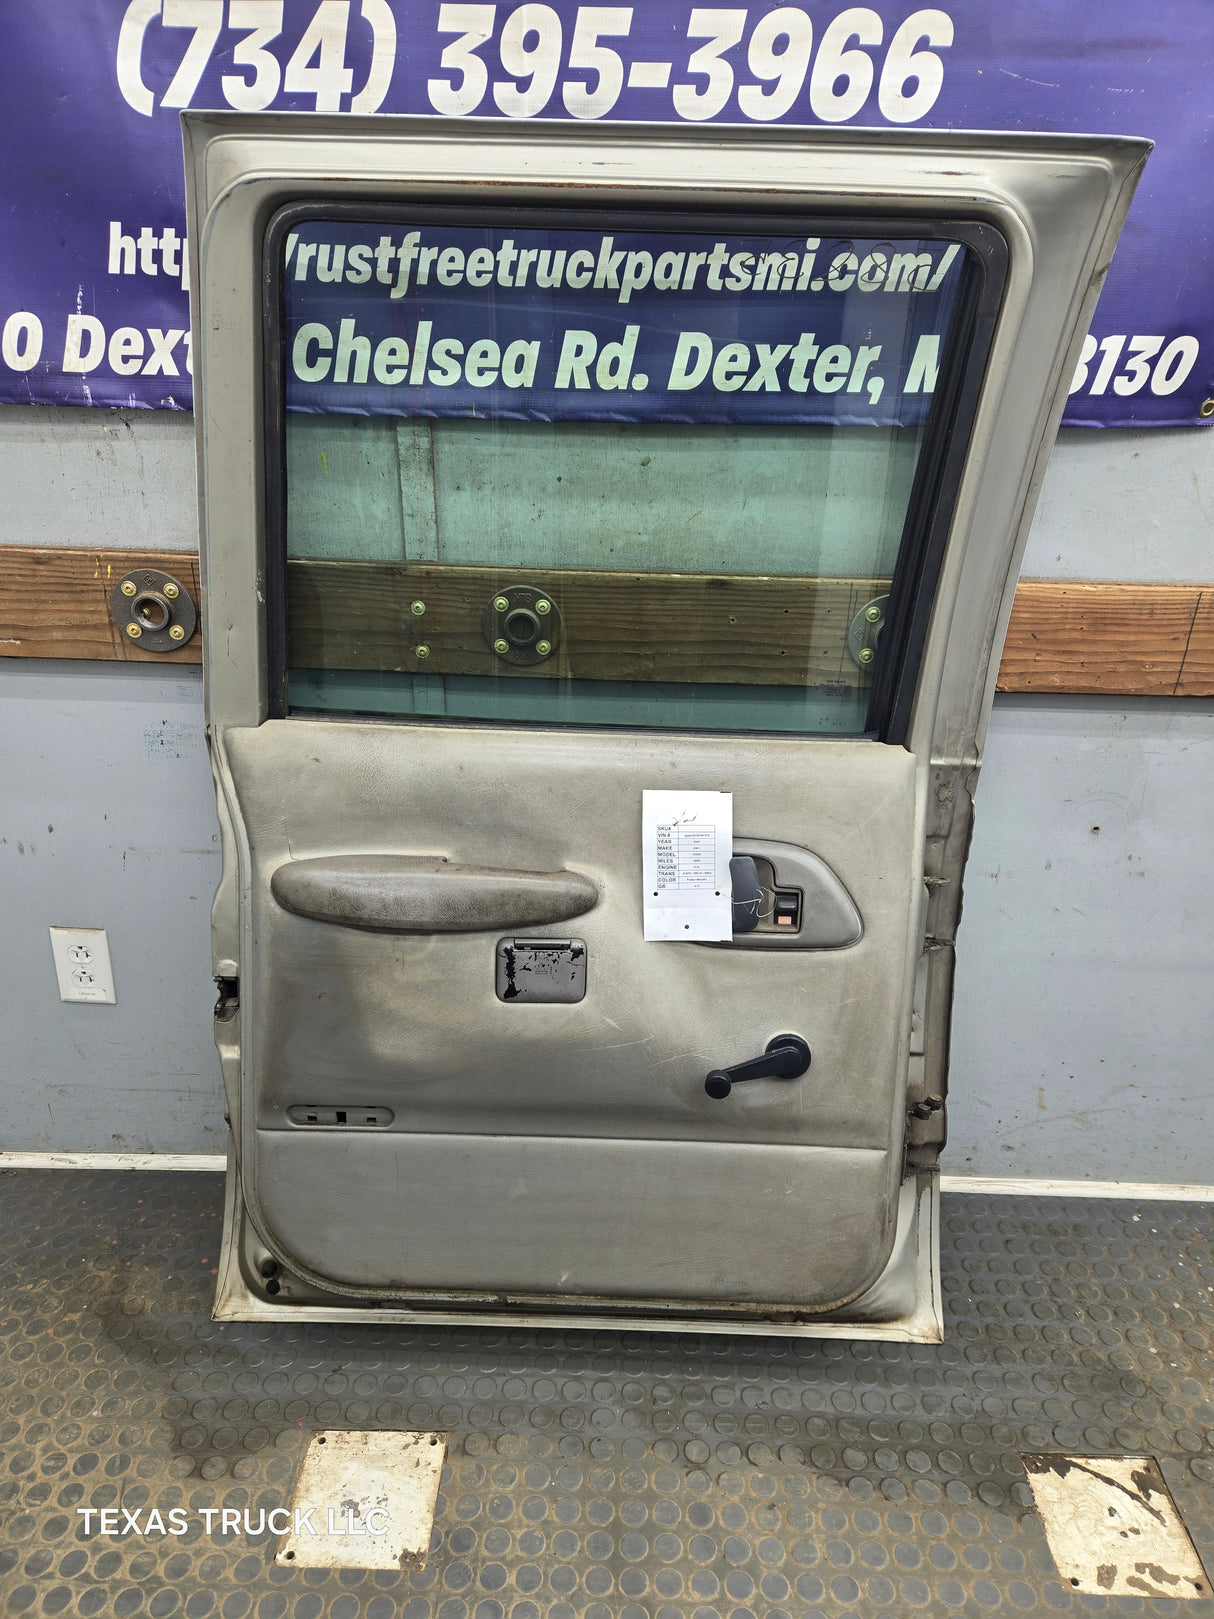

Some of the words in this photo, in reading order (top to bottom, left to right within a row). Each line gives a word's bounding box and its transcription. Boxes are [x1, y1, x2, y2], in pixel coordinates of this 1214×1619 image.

[117, 0, 397, 117] (734)
[427, 3, 955, 123] 395-3966
[292, 318, 541, 390] Chelsea
[554, 325, 650, 391] Rd.
[667, 331, 885, 405] Dexter,
